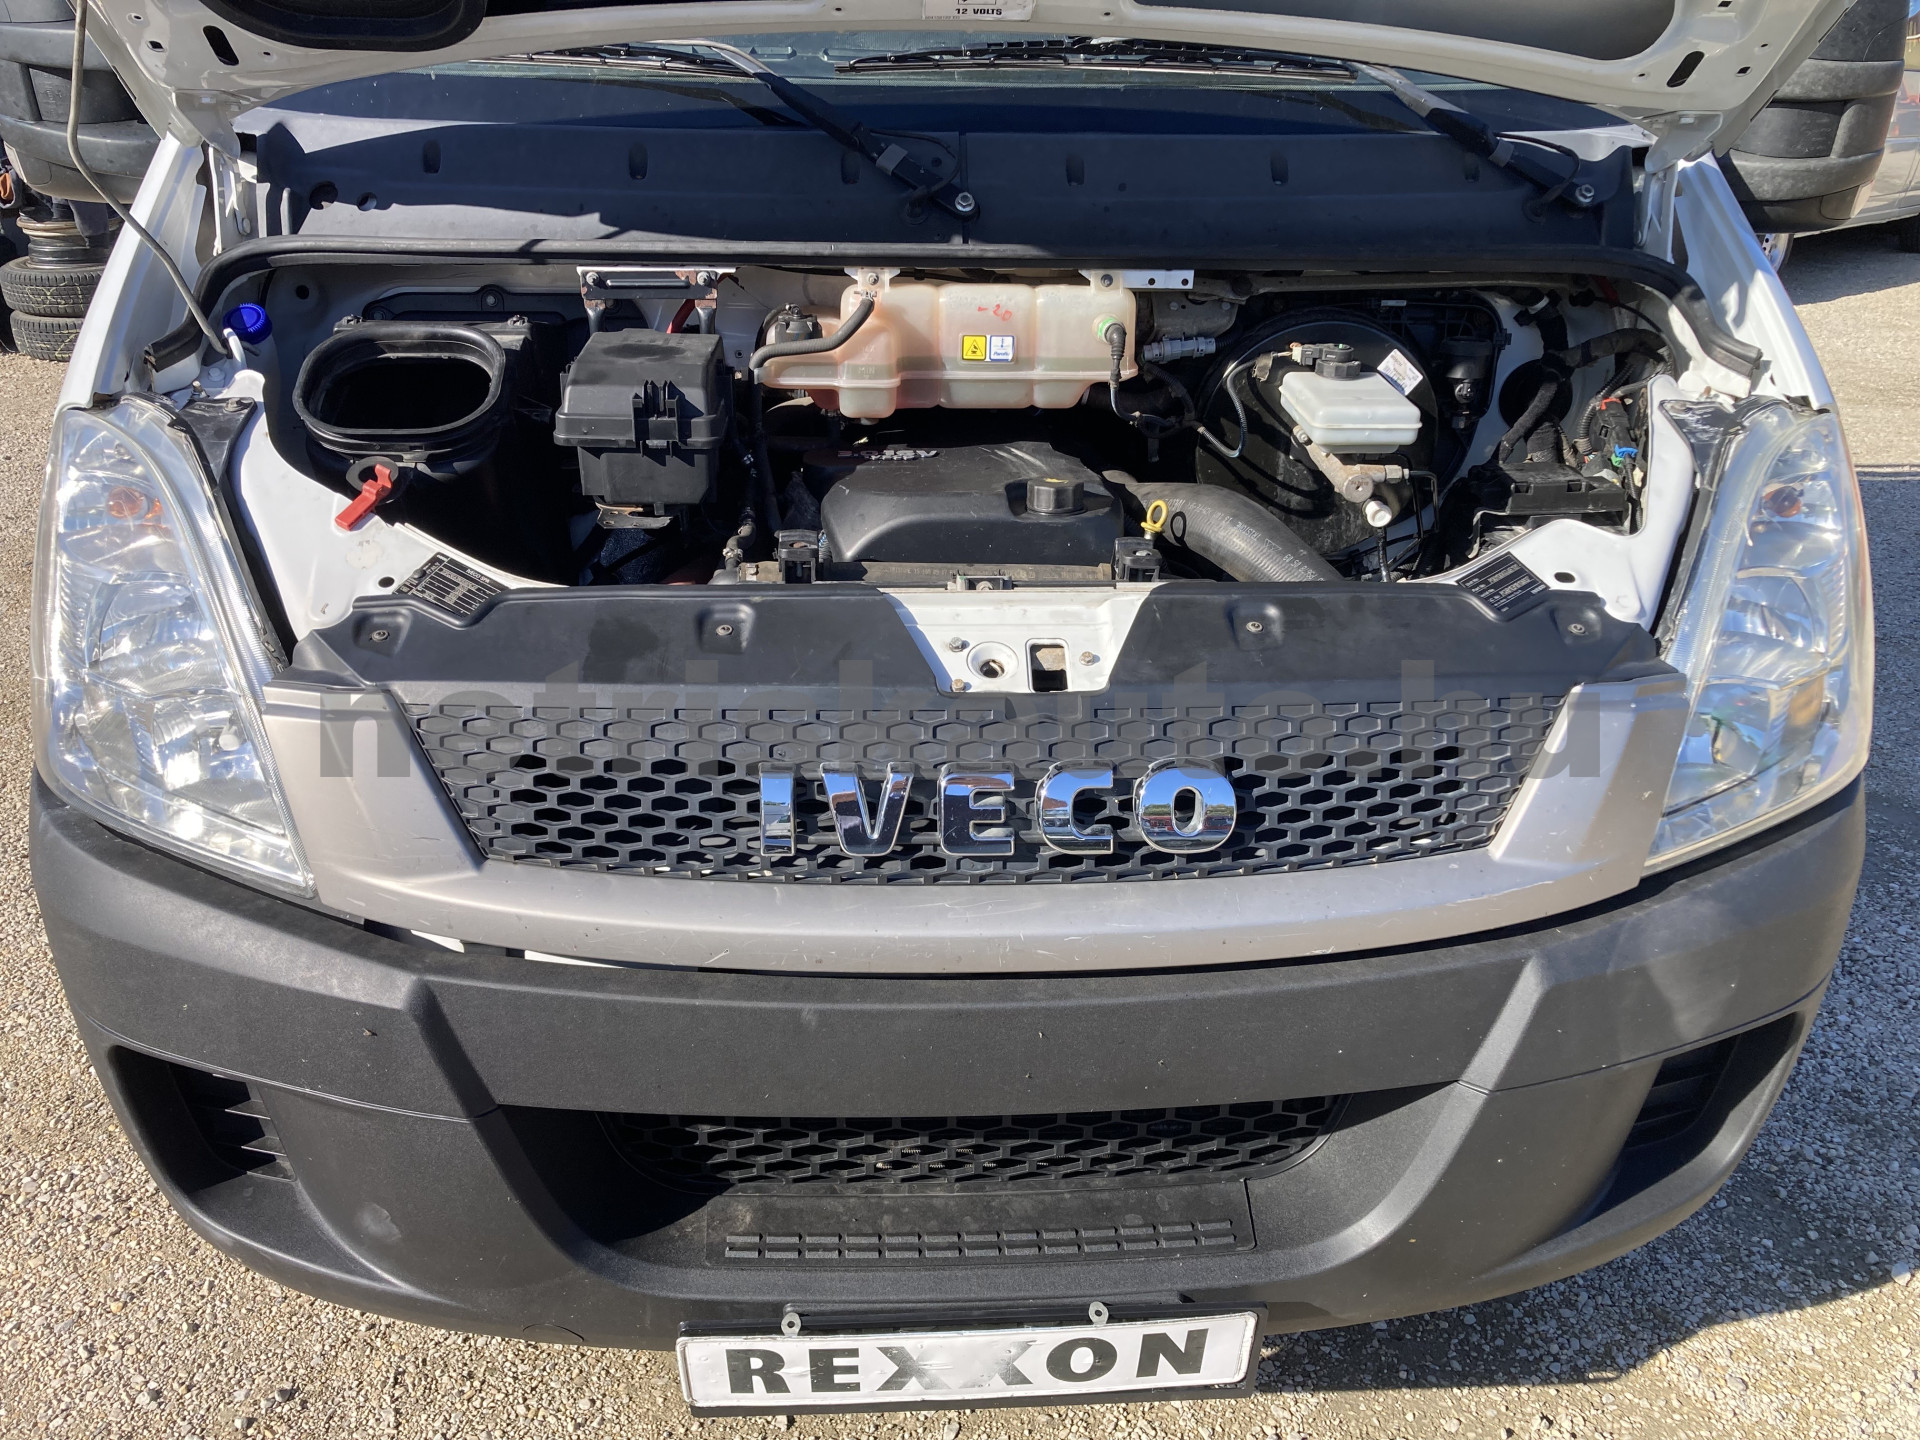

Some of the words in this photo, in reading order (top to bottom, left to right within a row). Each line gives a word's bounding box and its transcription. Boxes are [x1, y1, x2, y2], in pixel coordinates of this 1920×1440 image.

[466, 568, 481, 581] IVECO
[758, 757, 1239, 857] IVECO
[724, 1328, 1209, 1394] REXXON
